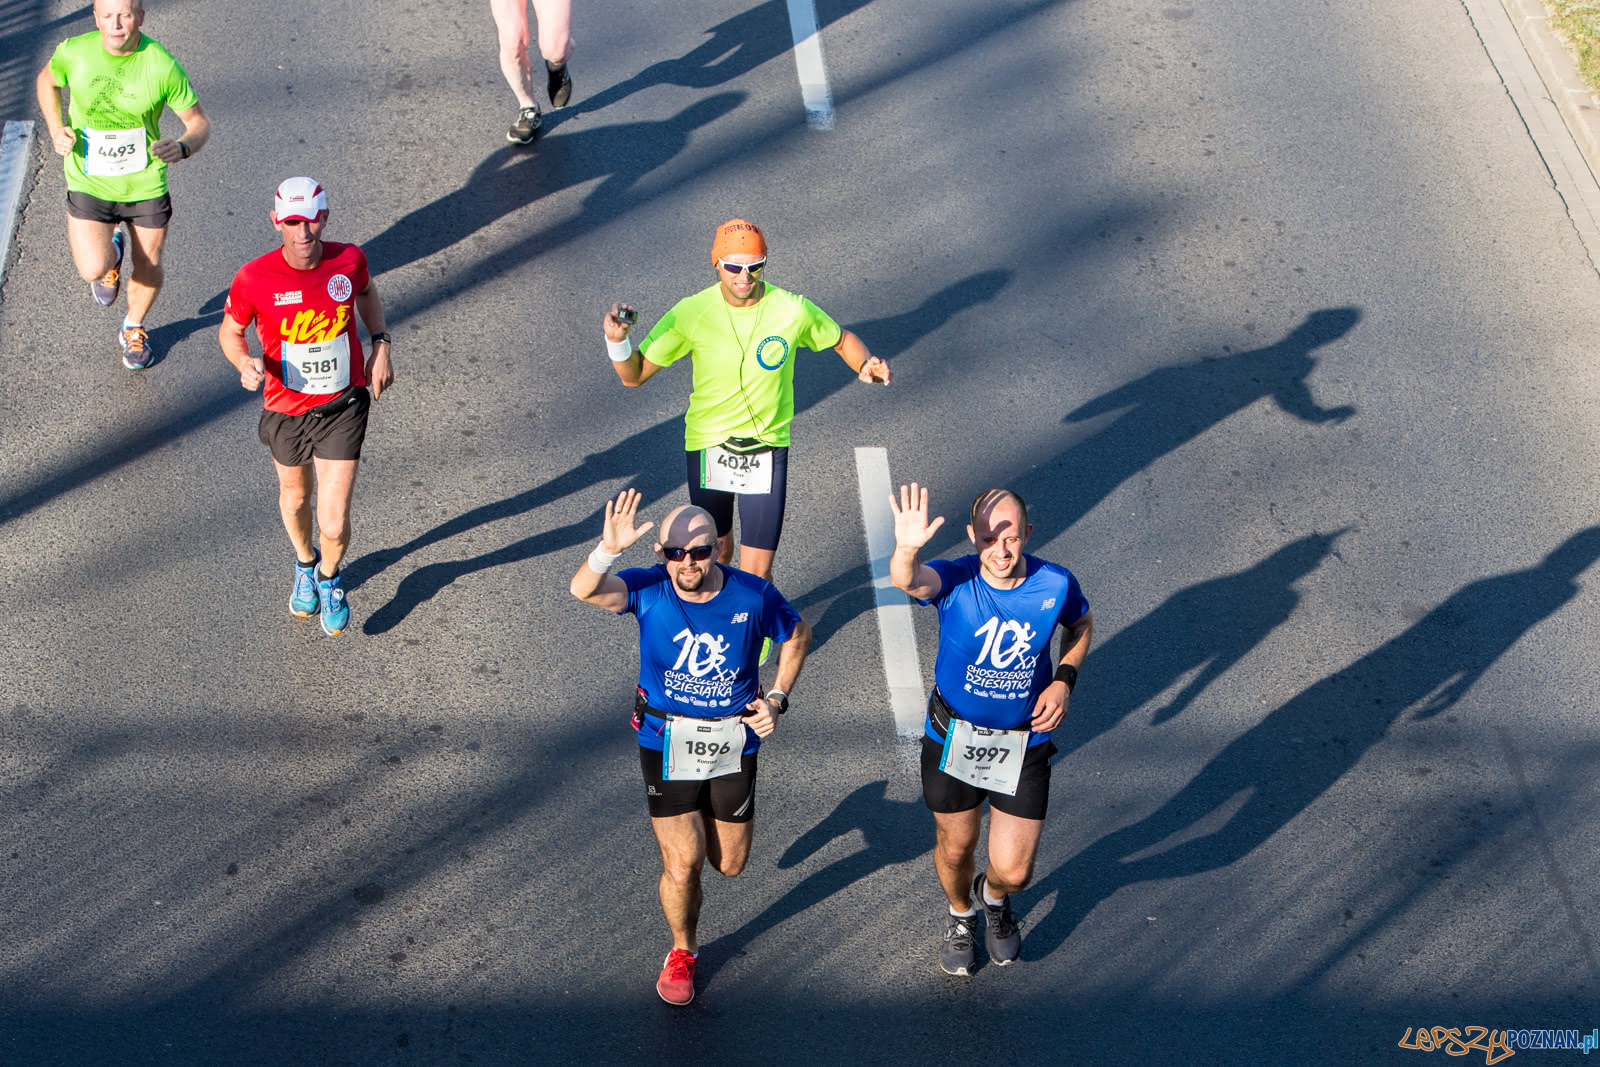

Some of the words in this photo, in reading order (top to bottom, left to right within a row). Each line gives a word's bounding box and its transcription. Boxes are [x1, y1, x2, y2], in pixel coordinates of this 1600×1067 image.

[98, 143, 136, 158] 4493
[302, 357, 338, 374] 5181
[717, 454, 761, 472] 4024
[664, 677, 732, 699] DZIESIĄTKA
[965, 671, 1032, 692] DZIESIĄTKA
[685, 740, 731, 757] 1896
[963, 745, 1011, 764] 3997
